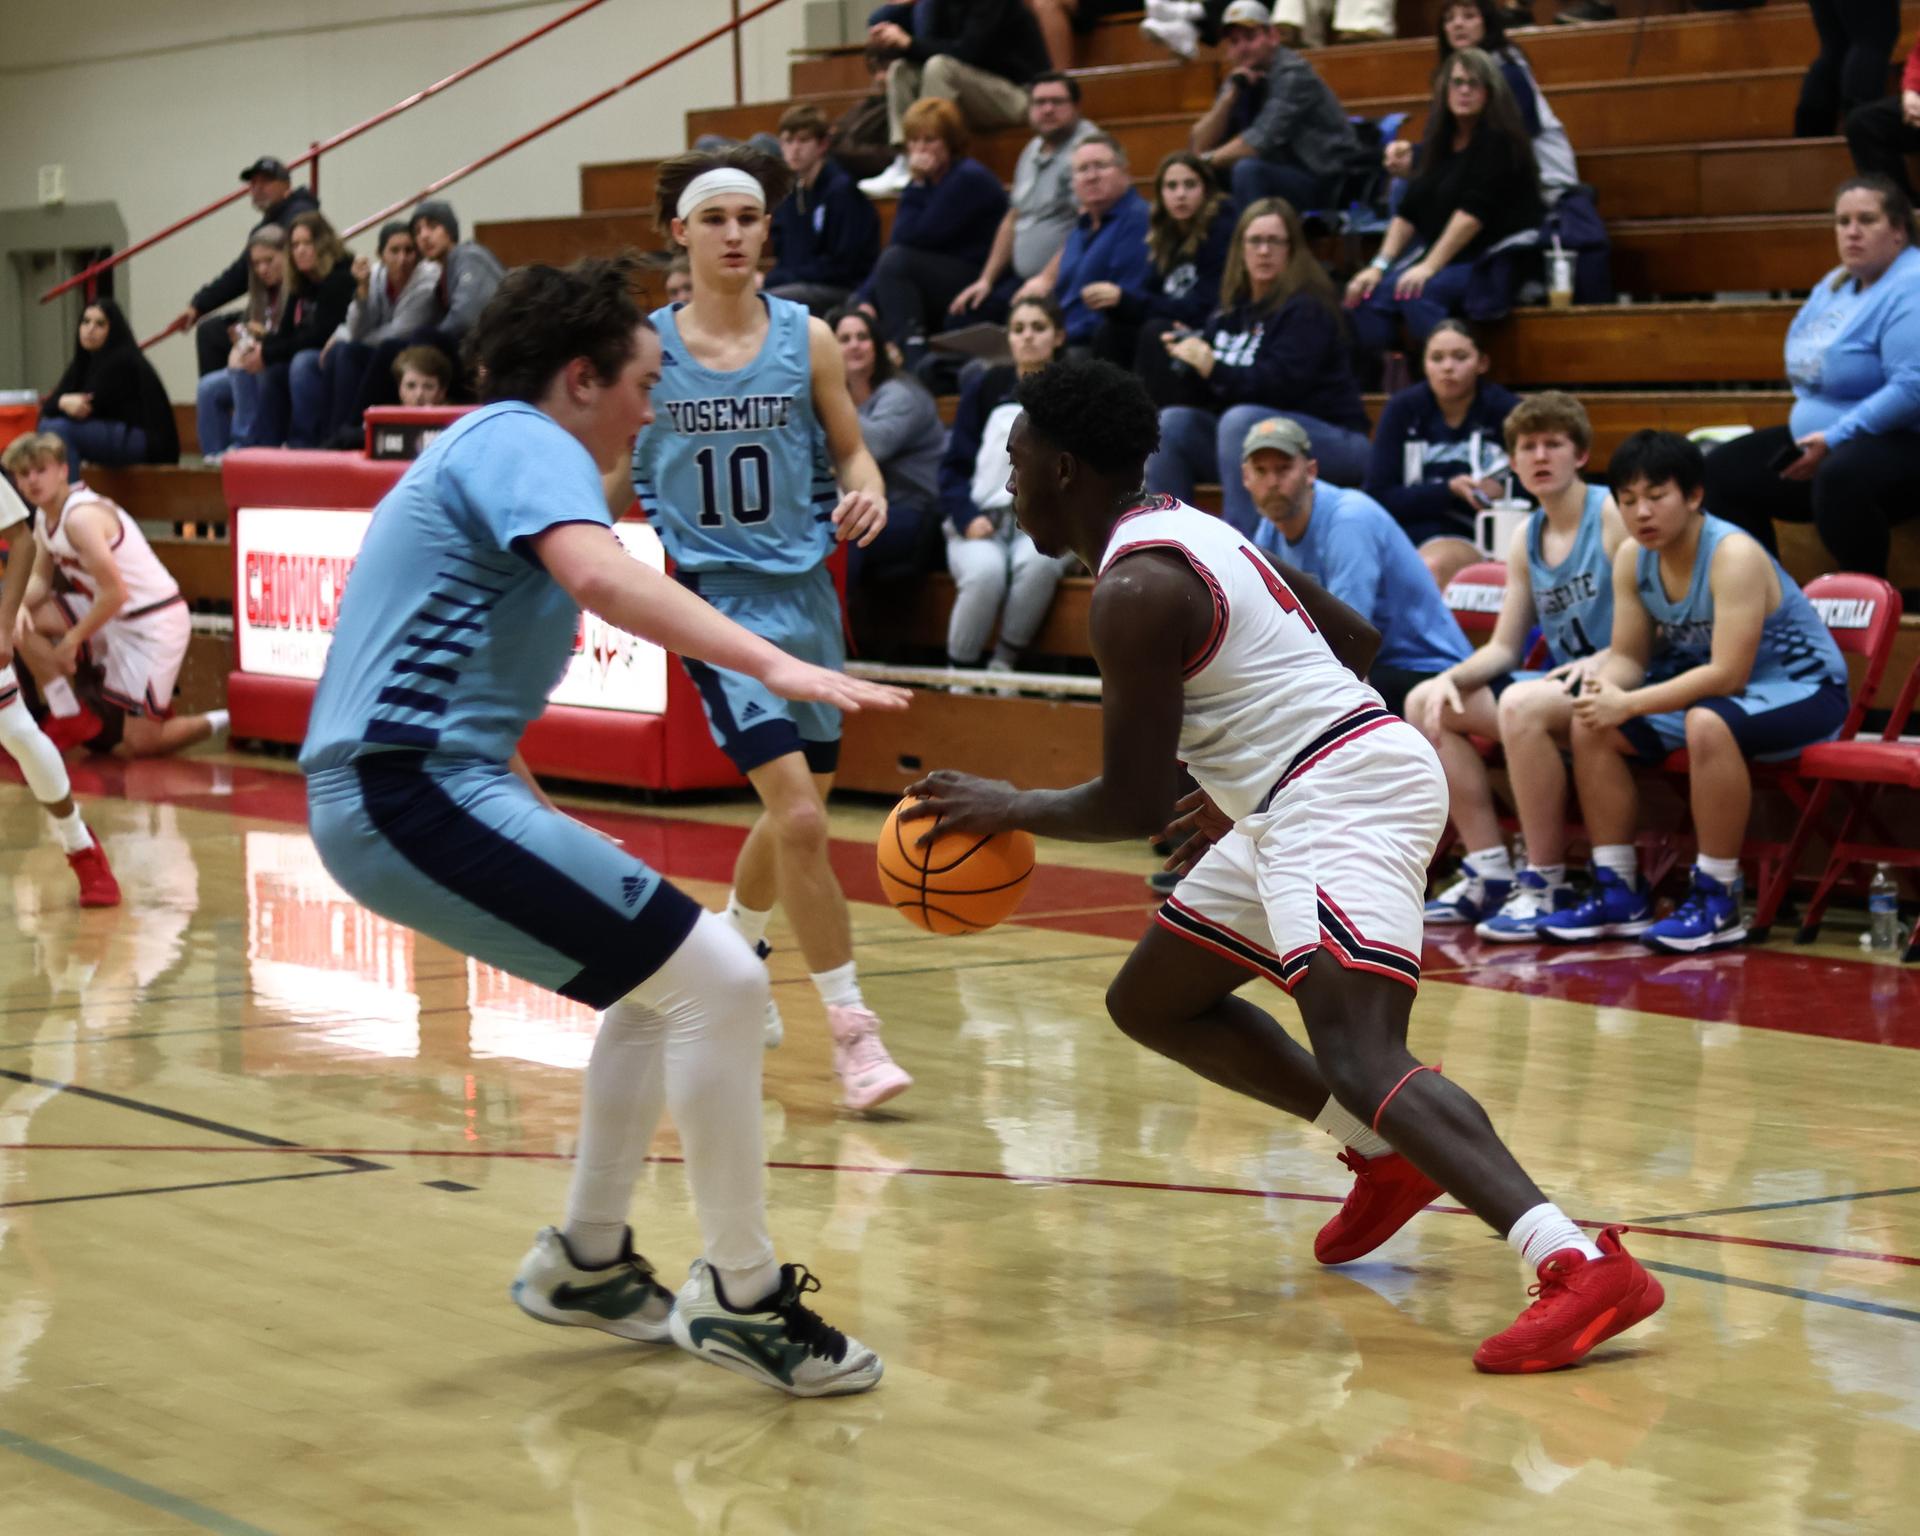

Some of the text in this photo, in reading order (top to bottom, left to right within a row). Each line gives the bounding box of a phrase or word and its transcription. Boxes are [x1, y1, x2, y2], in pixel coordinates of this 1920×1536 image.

[666, 394, 795, 434] YOSEMITE
[694, 443, 773, 527] 10
[246, 551, 355, 634] CHOWCH
[1238, 545, 1317, 634] 4
